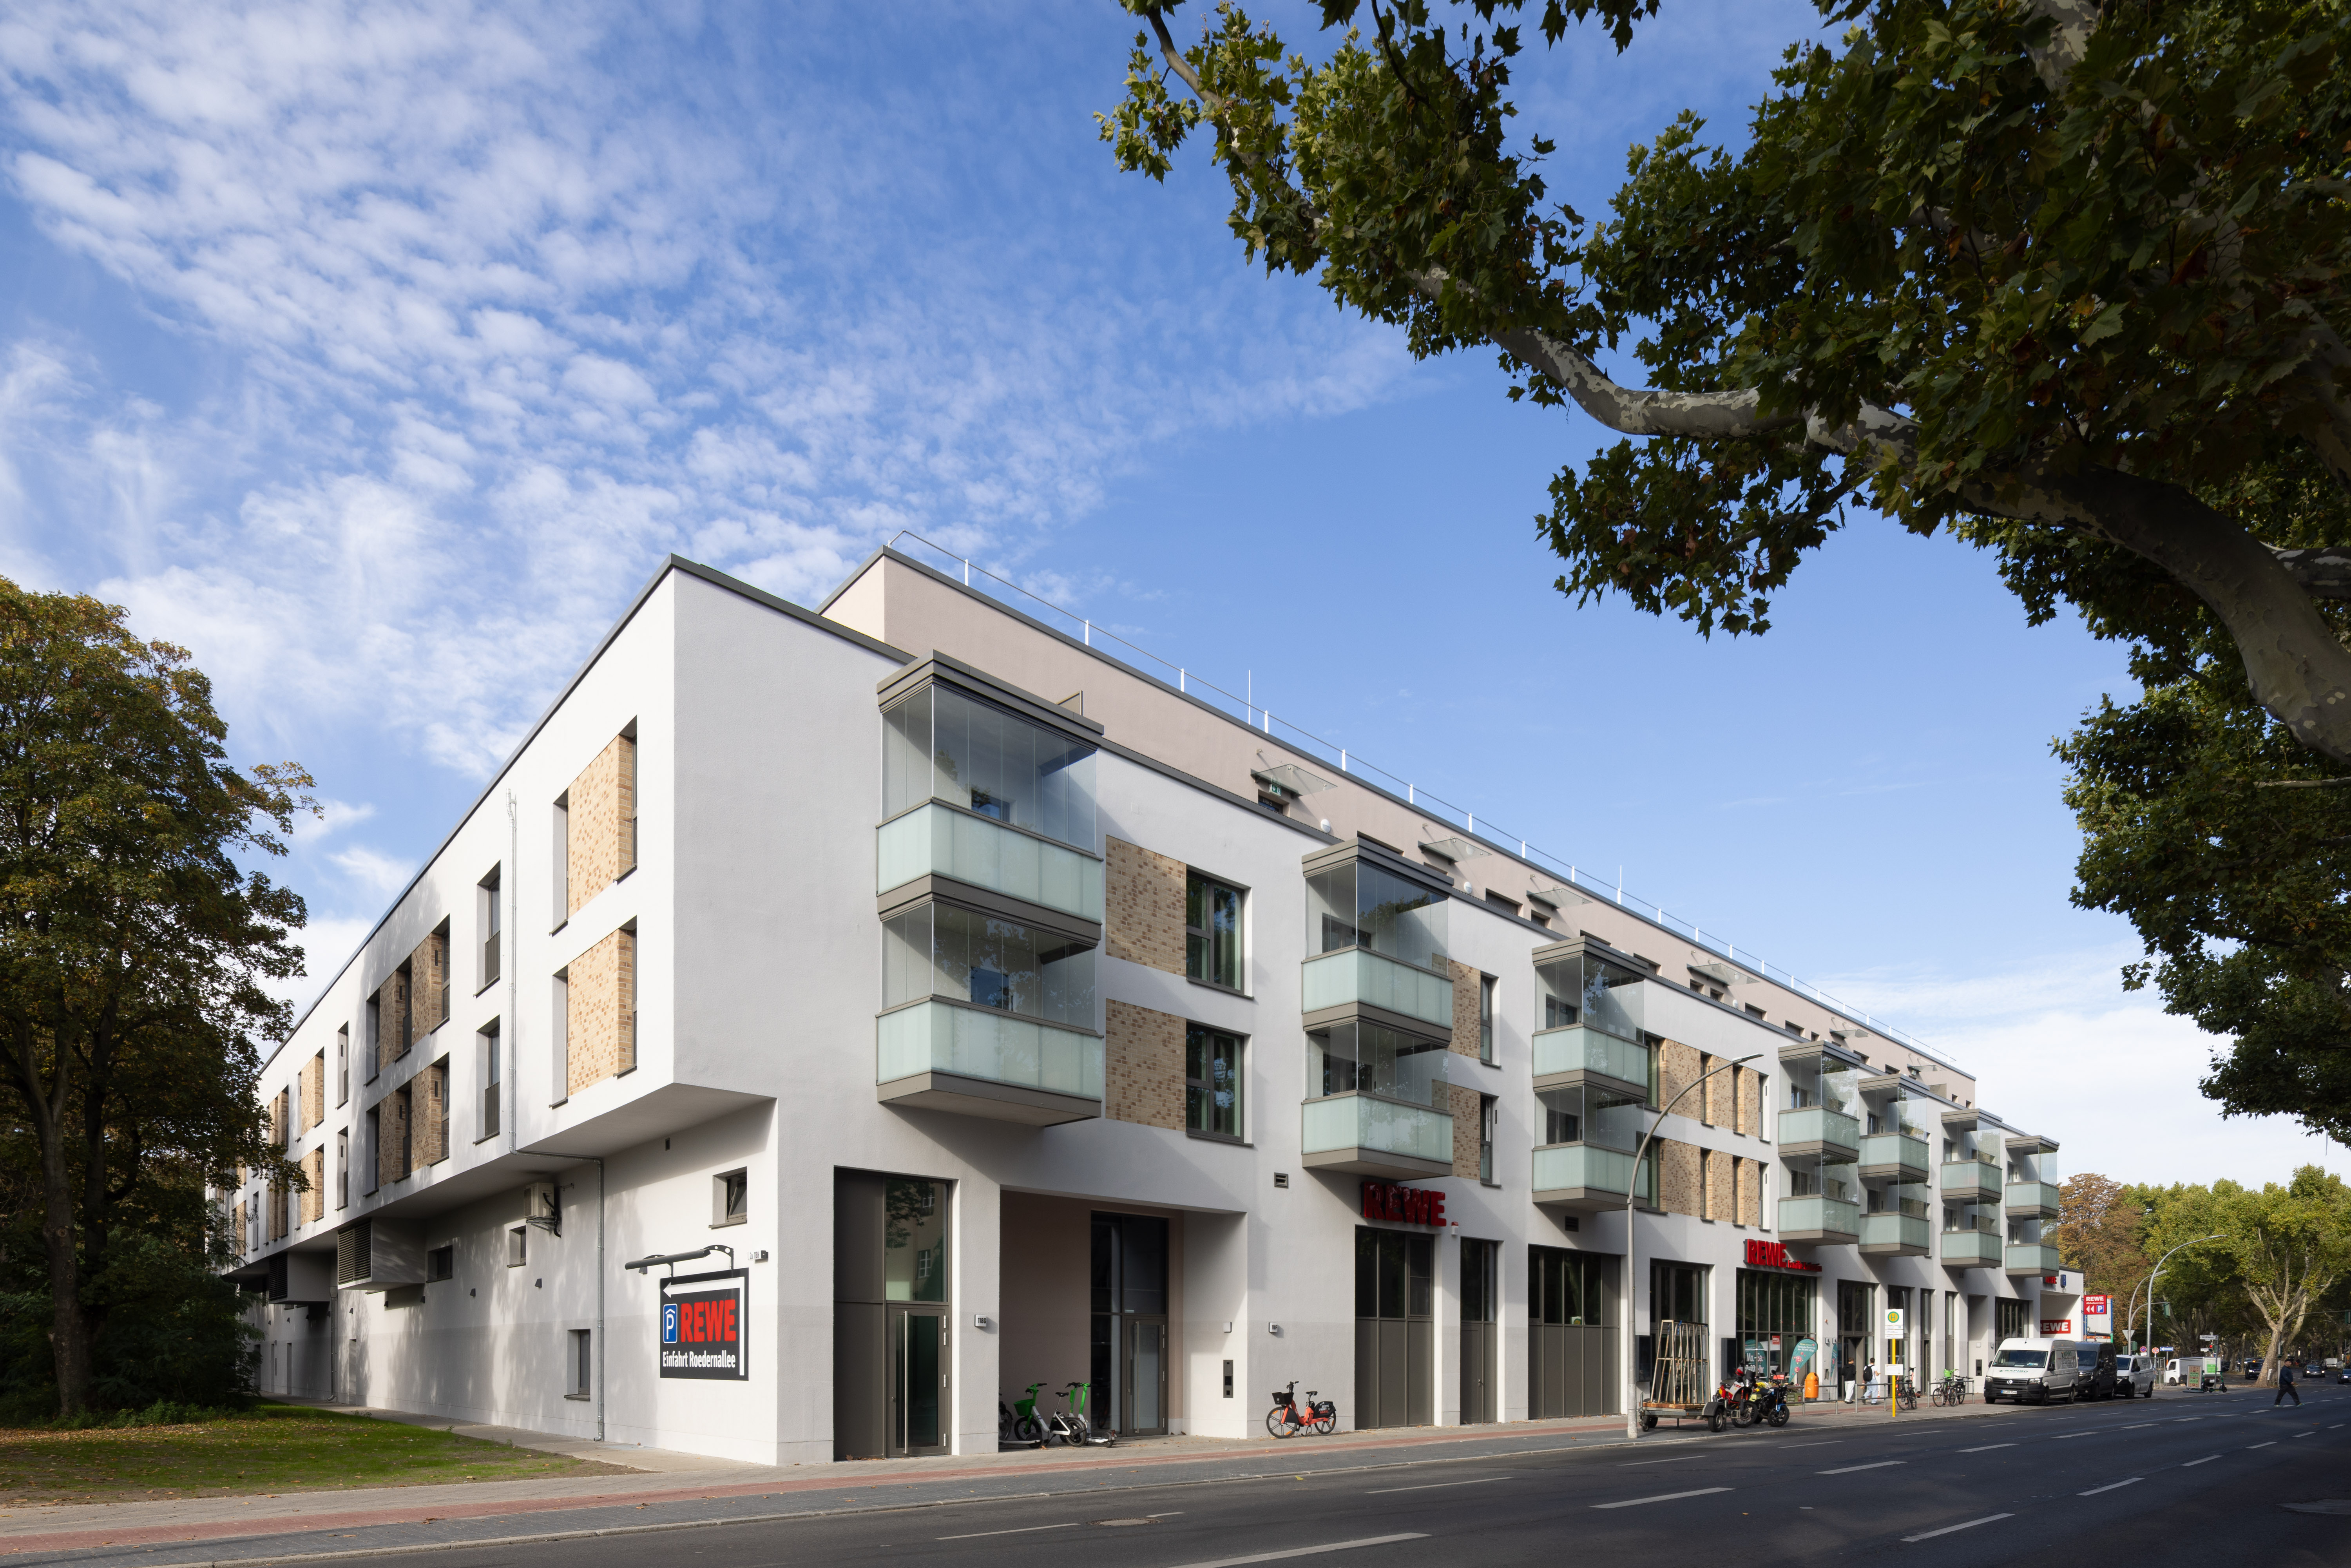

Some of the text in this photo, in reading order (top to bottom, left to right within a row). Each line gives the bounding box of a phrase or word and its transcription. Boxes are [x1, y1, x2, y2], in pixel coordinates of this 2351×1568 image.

[1364, 1181, 1447, 1227] REWE
[1747, 1238, 1787, 1268] REWE
[681, 1299, 736, 1342] REWE
[663, 1350, 736, 1368] Einfahrt Roedernallee
